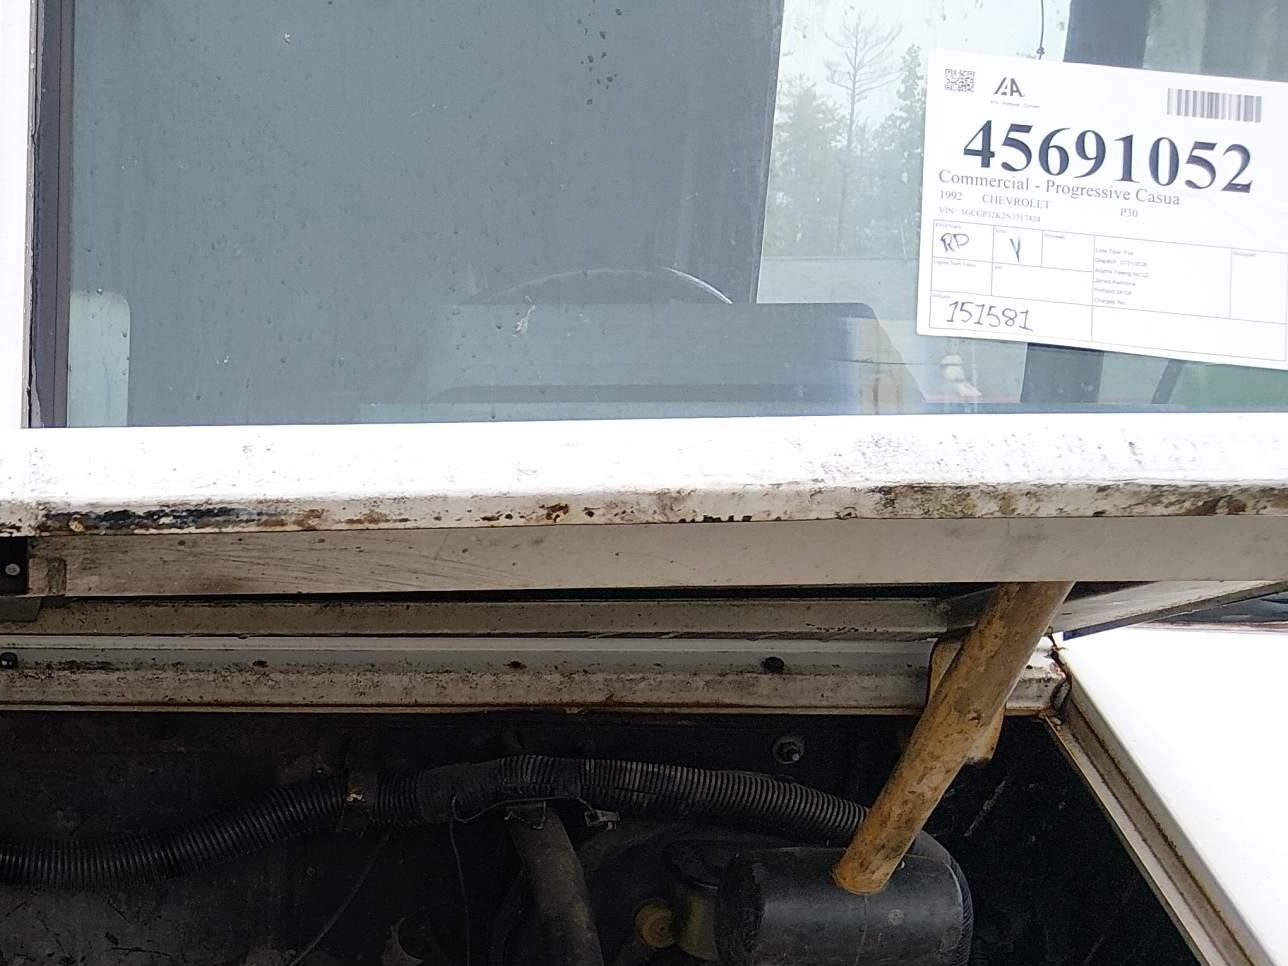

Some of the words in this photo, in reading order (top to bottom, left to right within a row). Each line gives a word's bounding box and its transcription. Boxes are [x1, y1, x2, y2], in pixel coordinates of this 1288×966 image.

[963, 119, 1253, 194] 45691052
[938, 168, 1030, 191] Commercial
[1045, 179, 1131, 204] Progressive
[1135, 188, 1181, 206] Casua
[939, 189, 963, 201] 1992
[981, 193, 1050, 209] CHEVROLET
[1119, 207, 1139, 218] P30
[946, 300, 1034, 332] 151581
